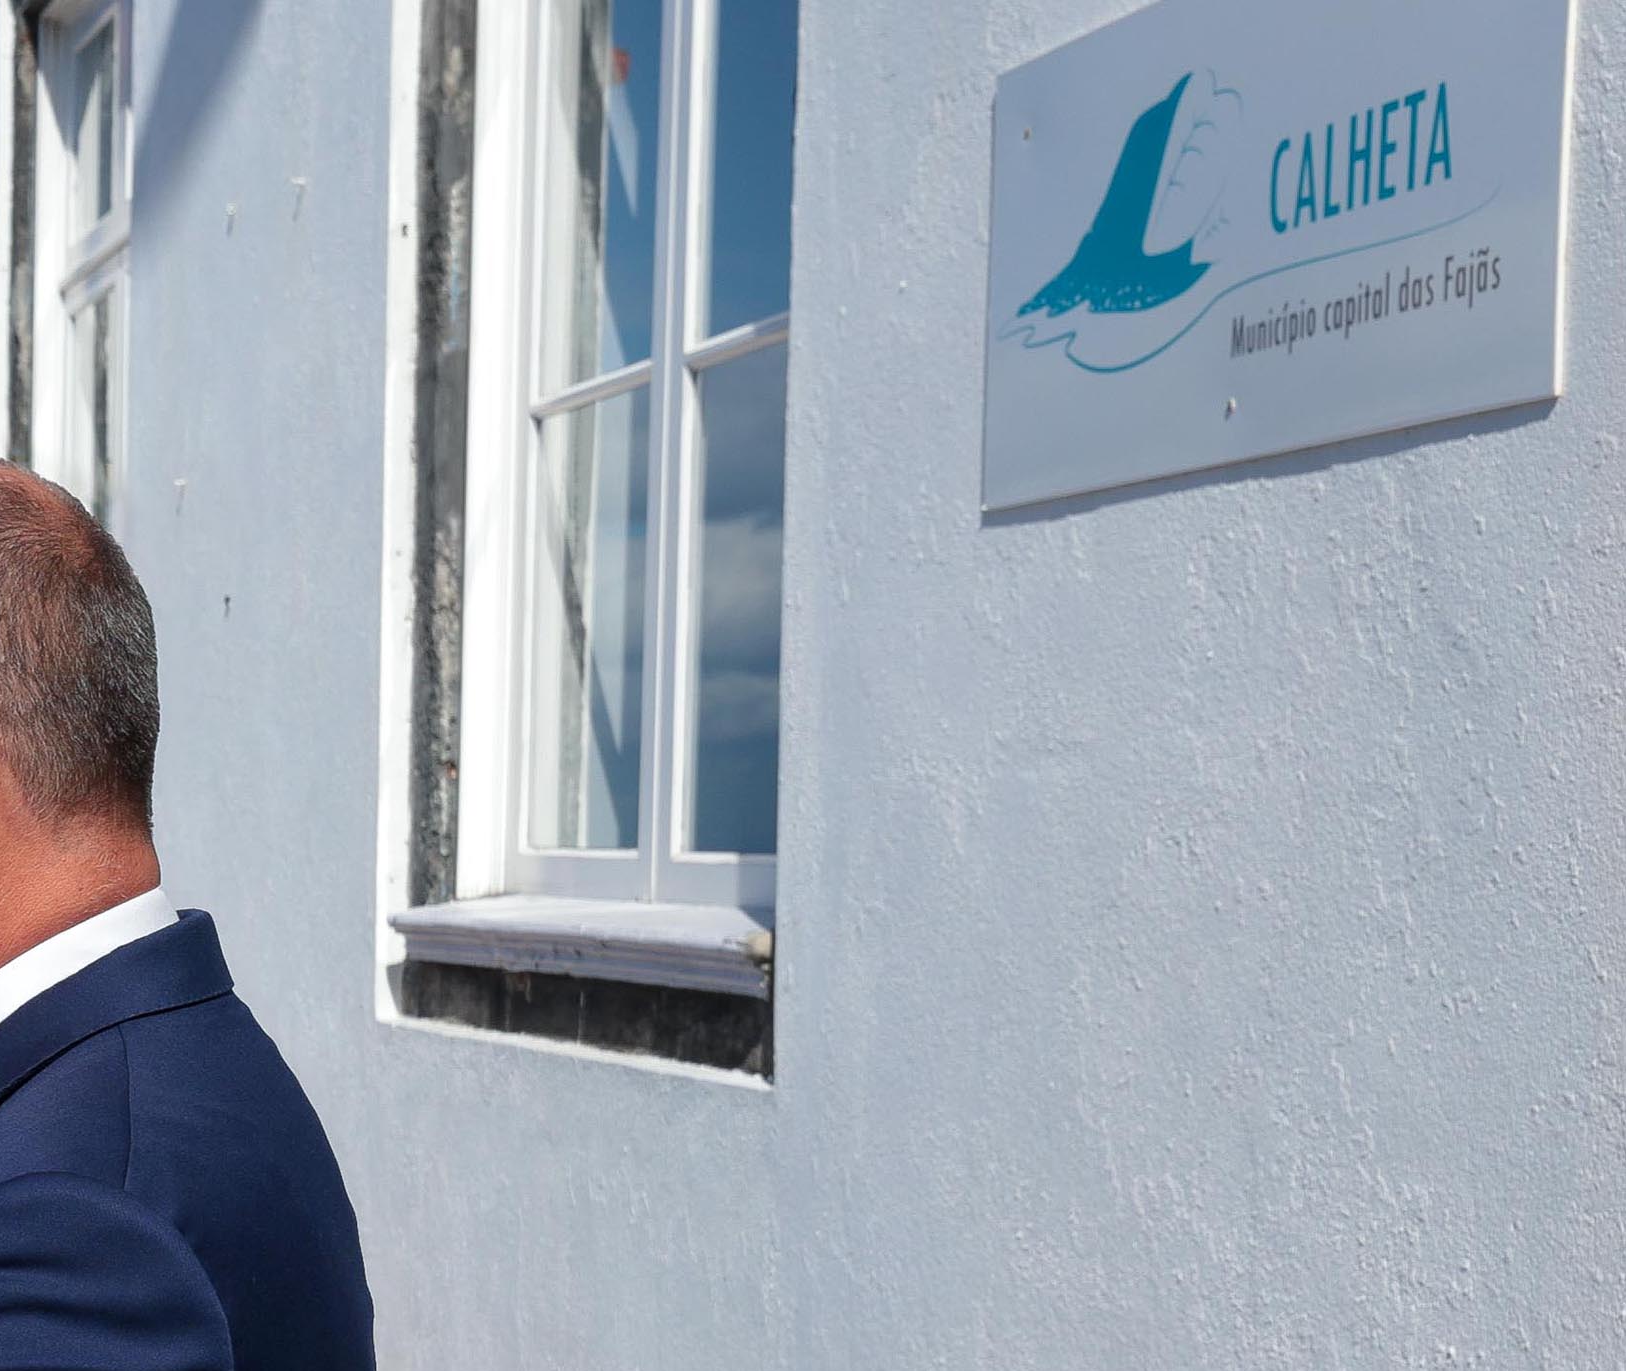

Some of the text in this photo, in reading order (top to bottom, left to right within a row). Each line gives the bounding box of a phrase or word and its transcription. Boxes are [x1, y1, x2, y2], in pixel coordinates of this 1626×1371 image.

[1269, 80, 1453, 234] CALHETA
[1230, 246, 1502, 358] Município capital das Fajãs
